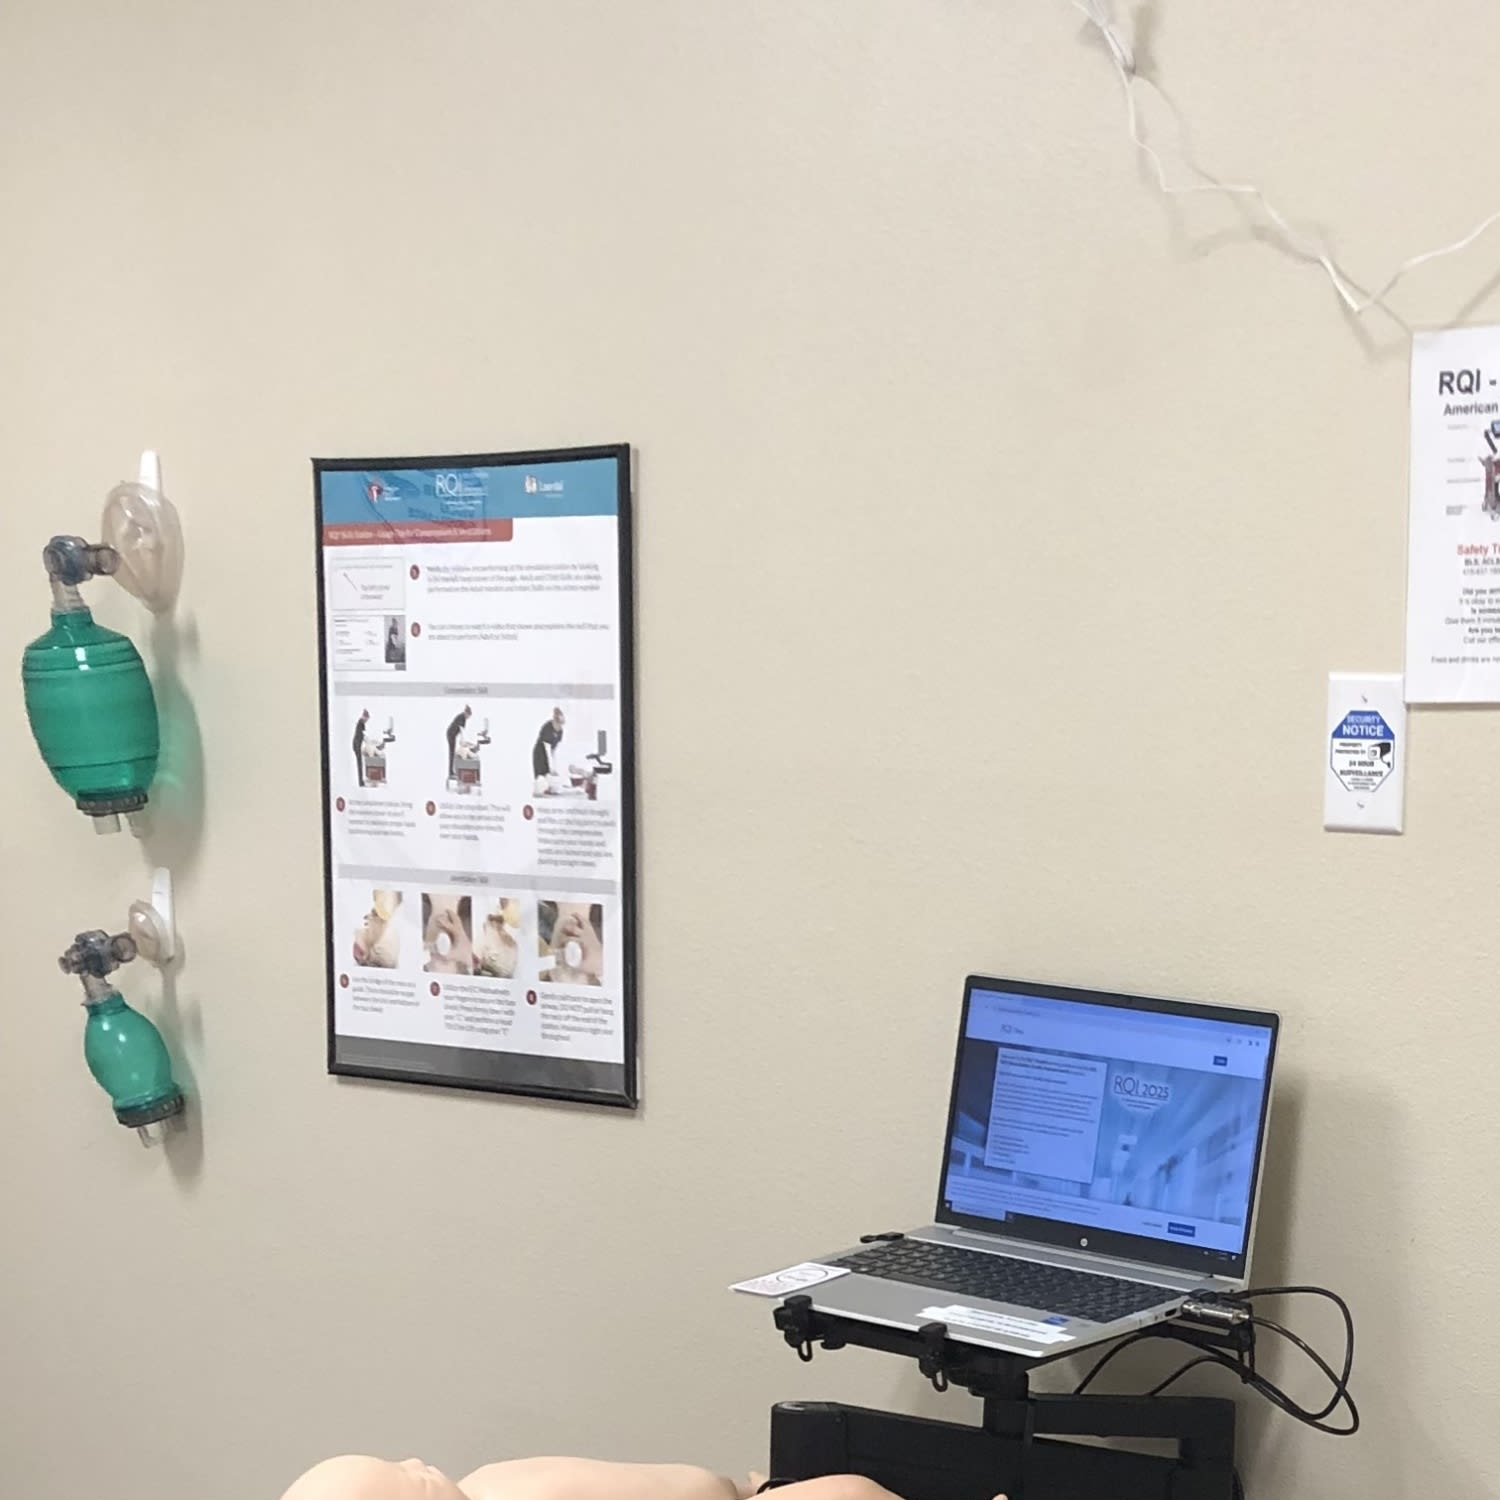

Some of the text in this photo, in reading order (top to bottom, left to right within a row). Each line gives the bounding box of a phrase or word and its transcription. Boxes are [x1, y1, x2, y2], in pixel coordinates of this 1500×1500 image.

[1438, 368, 1481, 396] RQI
[1443, 402, 1499, 417] American
[435, 473, 463, 497] RQI
[1456, 543, 1490, 559] Safety
[1346, 715, 1381, 724] SECURITY
[1342, 724, 1385, 737] NOTICE
[1114, 1075, 1170, 1100] RQI 2025
